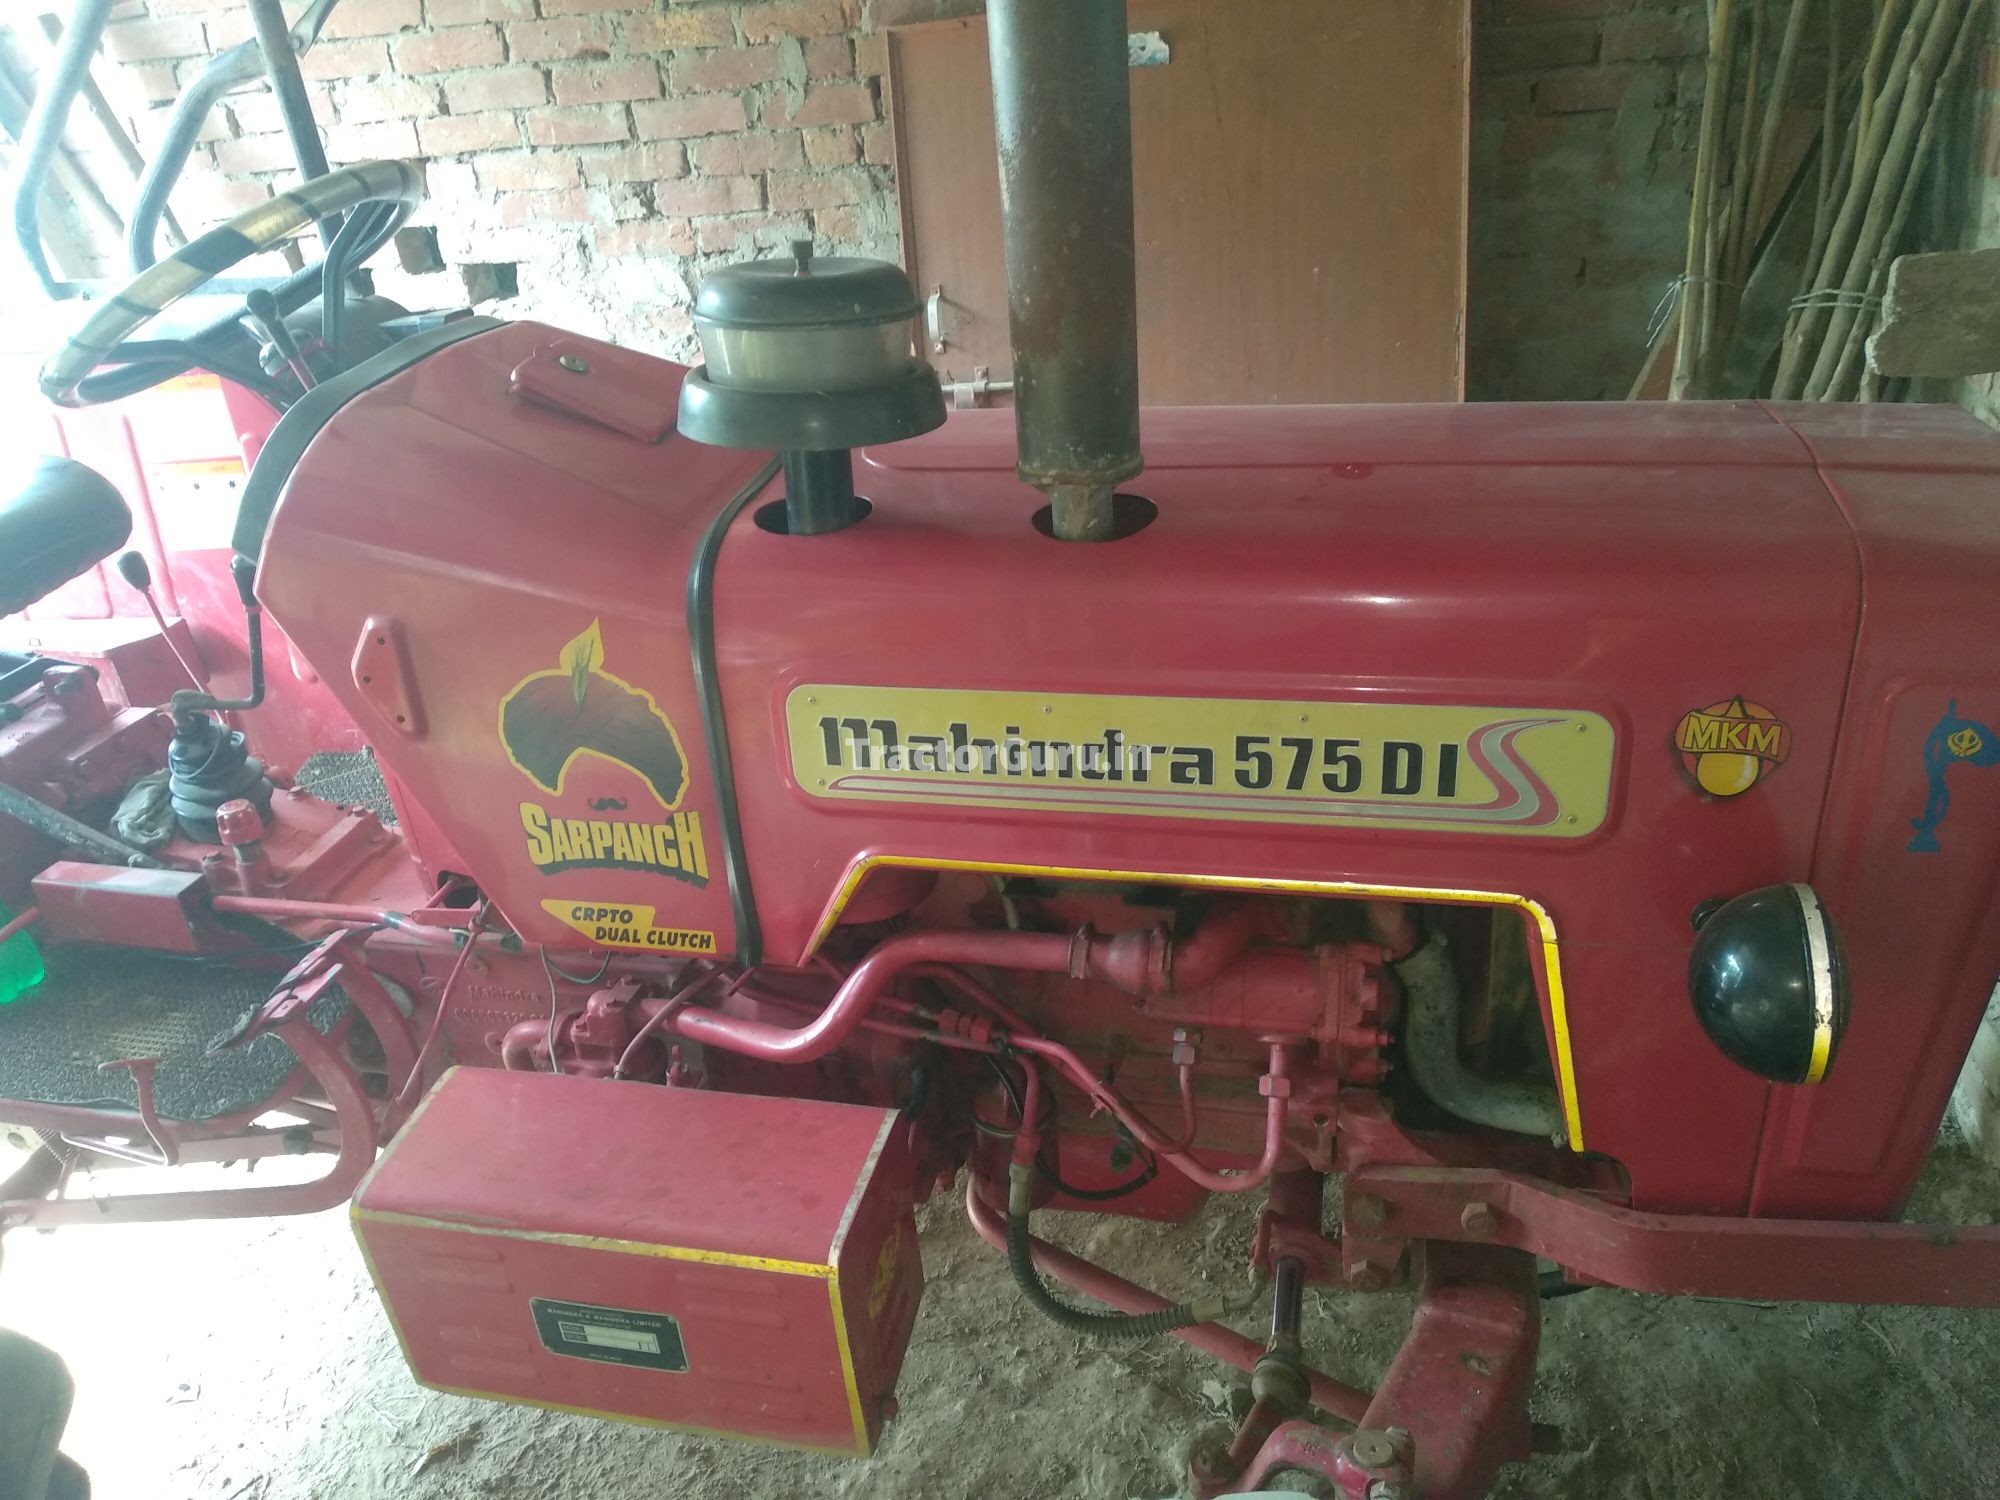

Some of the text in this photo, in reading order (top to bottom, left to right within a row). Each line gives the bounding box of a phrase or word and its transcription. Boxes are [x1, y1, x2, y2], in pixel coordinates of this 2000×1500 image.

[1682, 714, 1783, 757] MKM
[1234, 735, 1362, 793] 575
[1381, 740, 1459, 798] DI
[519, 801, 710, 885] SARPANCH
[571, 906, 633, 924] CRPTO
[595, 926, 711, 949] DUAL CLUTCH
